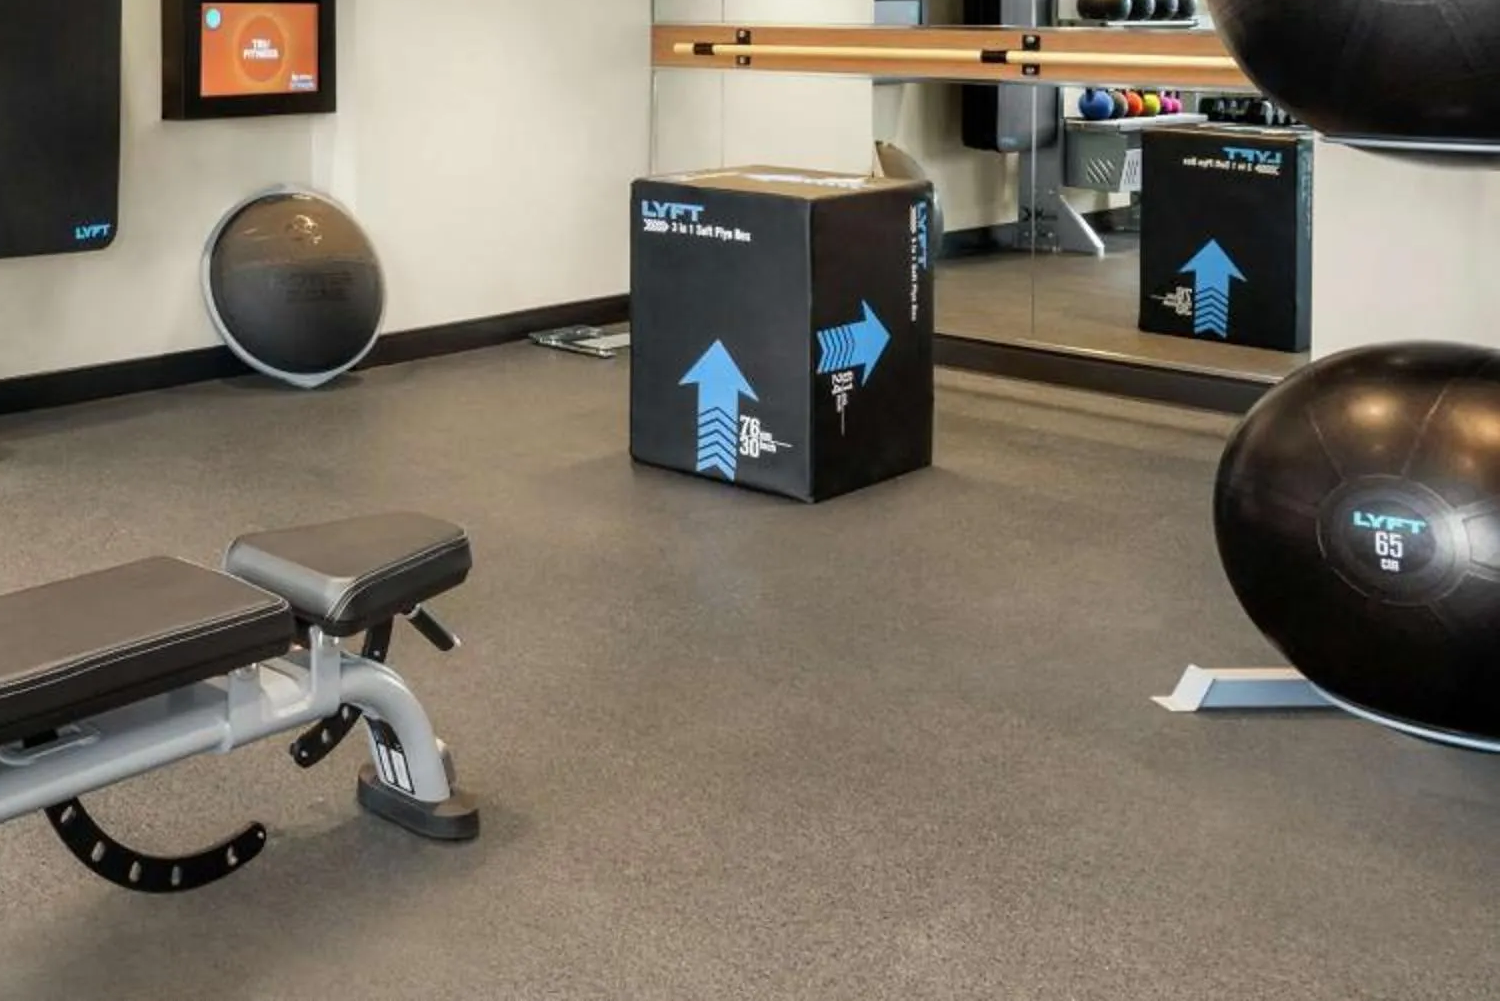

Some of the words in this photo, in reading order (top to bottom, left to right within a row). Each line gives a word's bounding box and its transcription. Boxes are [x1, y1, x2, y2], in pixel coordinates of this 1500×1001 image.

[642, 200, 705, 222] LYFT
[75, 224, 111, 240] LYFT
[740, 435, 760, 458] 30
[1353, 510, 1427, 533] LYFT
[1375, 531, 1403, 558] 65
